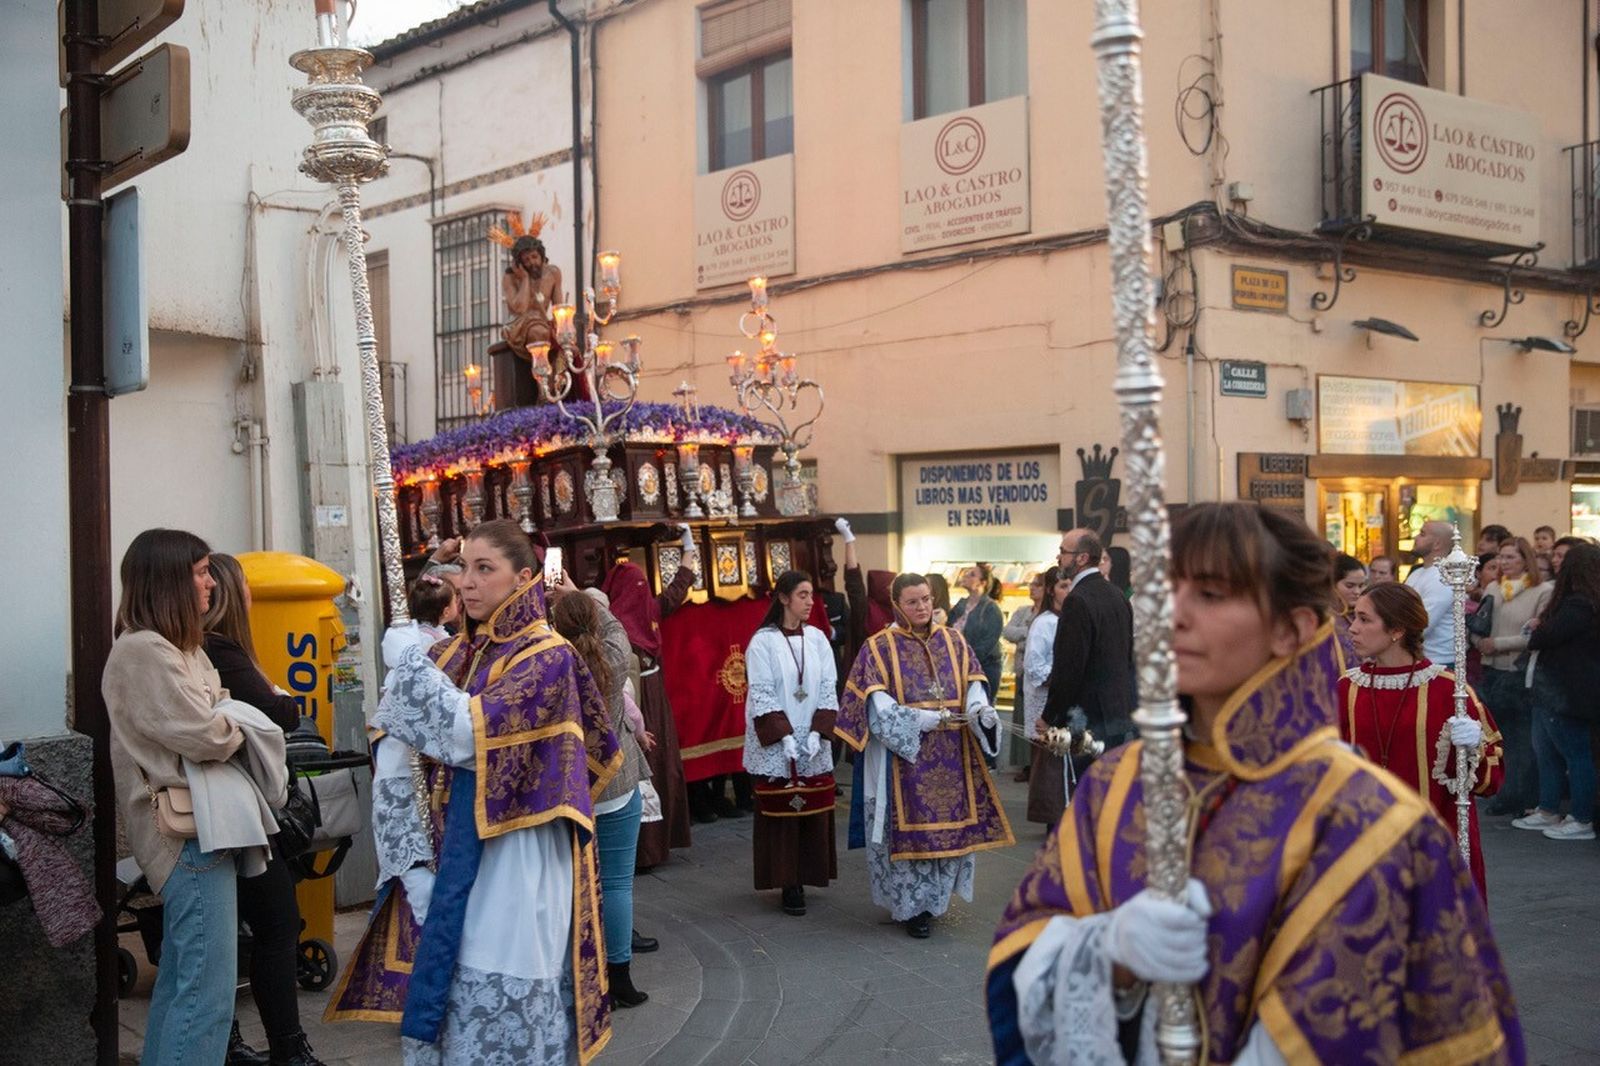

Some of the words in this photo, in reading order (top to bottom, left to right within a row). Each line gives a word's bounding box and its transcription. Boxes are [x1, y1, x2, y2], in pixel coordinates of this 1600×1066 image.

[944, 135, 977, 157] L&C
[1433, 123, 1463, 146] LAO
[1466, 131, 1476, 149] &
[1480, 133, 1535, 161] CASTRO
[1445, 152, 1526, 183] ABOGADOS
[903, 185, 936, 204] LAO
[940, 182, 951, 198] &
[955, 168, 1022, 194] CASTRO
[924, 191, 1001, 215] ABOGADOS
[947, 211, 985, 228] ACCIDENTES
[986, 210, 994, 220] DE
[698, 229, 723, 246] LAO
[725, 227, 734, 241] &
[737, 216, 788, 237] CASTRO
[941, 226, 976, 239] DIVORCIOS
[713, 235, 773, 256] ABOGADOS
[1240, 276, 1260, 288] PLAZA
[1231, 367, 1258, 379] CALLE
[1223, 380, 1231, 390] LA
[920, 465, 992, 484] DISPONEMOS
[997, 463, 1012, 481] DE
[1017, 461, 1040, 480] LOS
[915, 487, 954, 505] LIBROS
[958, 486, 983, 504] MAS
[988, 483, 1047, 503] VENDIDOS
[948, 510, 961, 527] EN
[966, 505, 1011, 526] ESPAÑA
